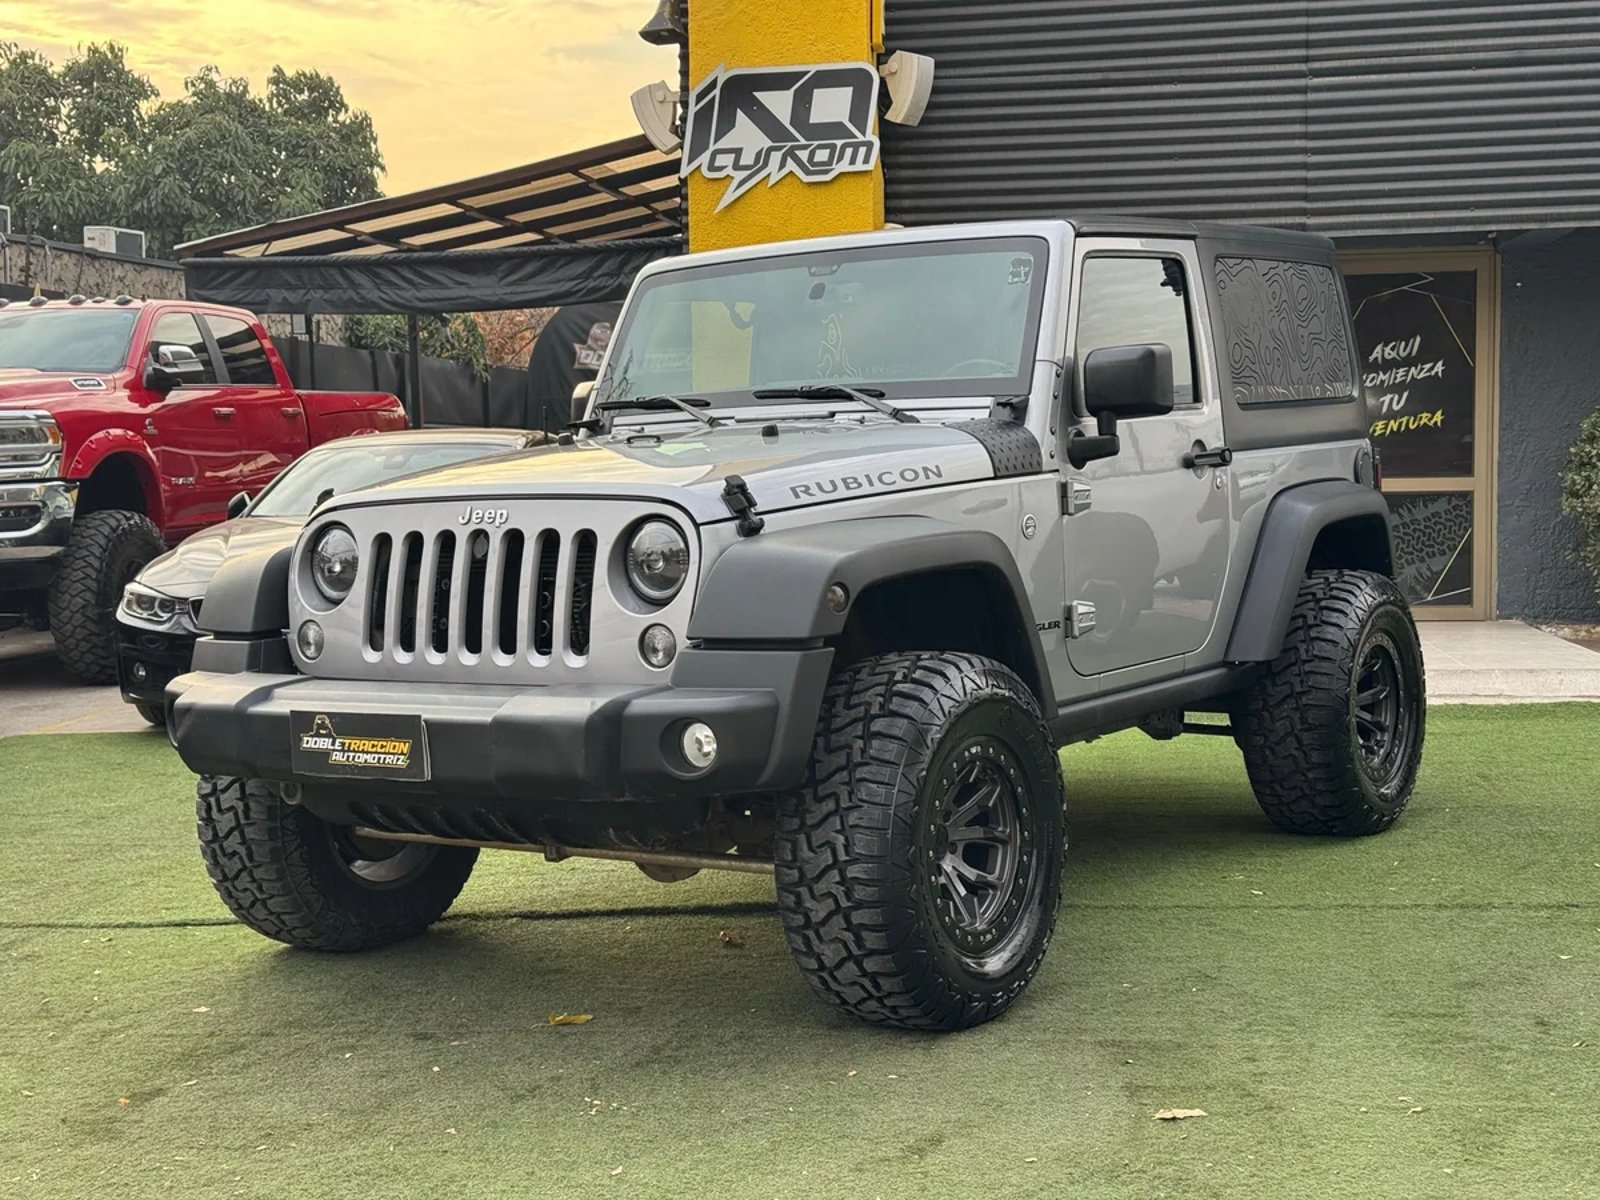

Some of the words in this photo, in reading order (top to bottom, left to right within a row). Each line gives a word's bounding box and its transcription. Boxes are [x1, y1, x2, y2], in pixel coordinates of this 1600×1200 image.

[1368, 334, 1421, 365] AQUI
[1363, 359, 1446, 388] OMIENZA
[1379, 389, 1410, 415] TU
[789, 464, 944, 499] RUBICON
[458, 504, 509, 528] Jeep
[331, 751, 406, 765] AUTOMOTRIZ
